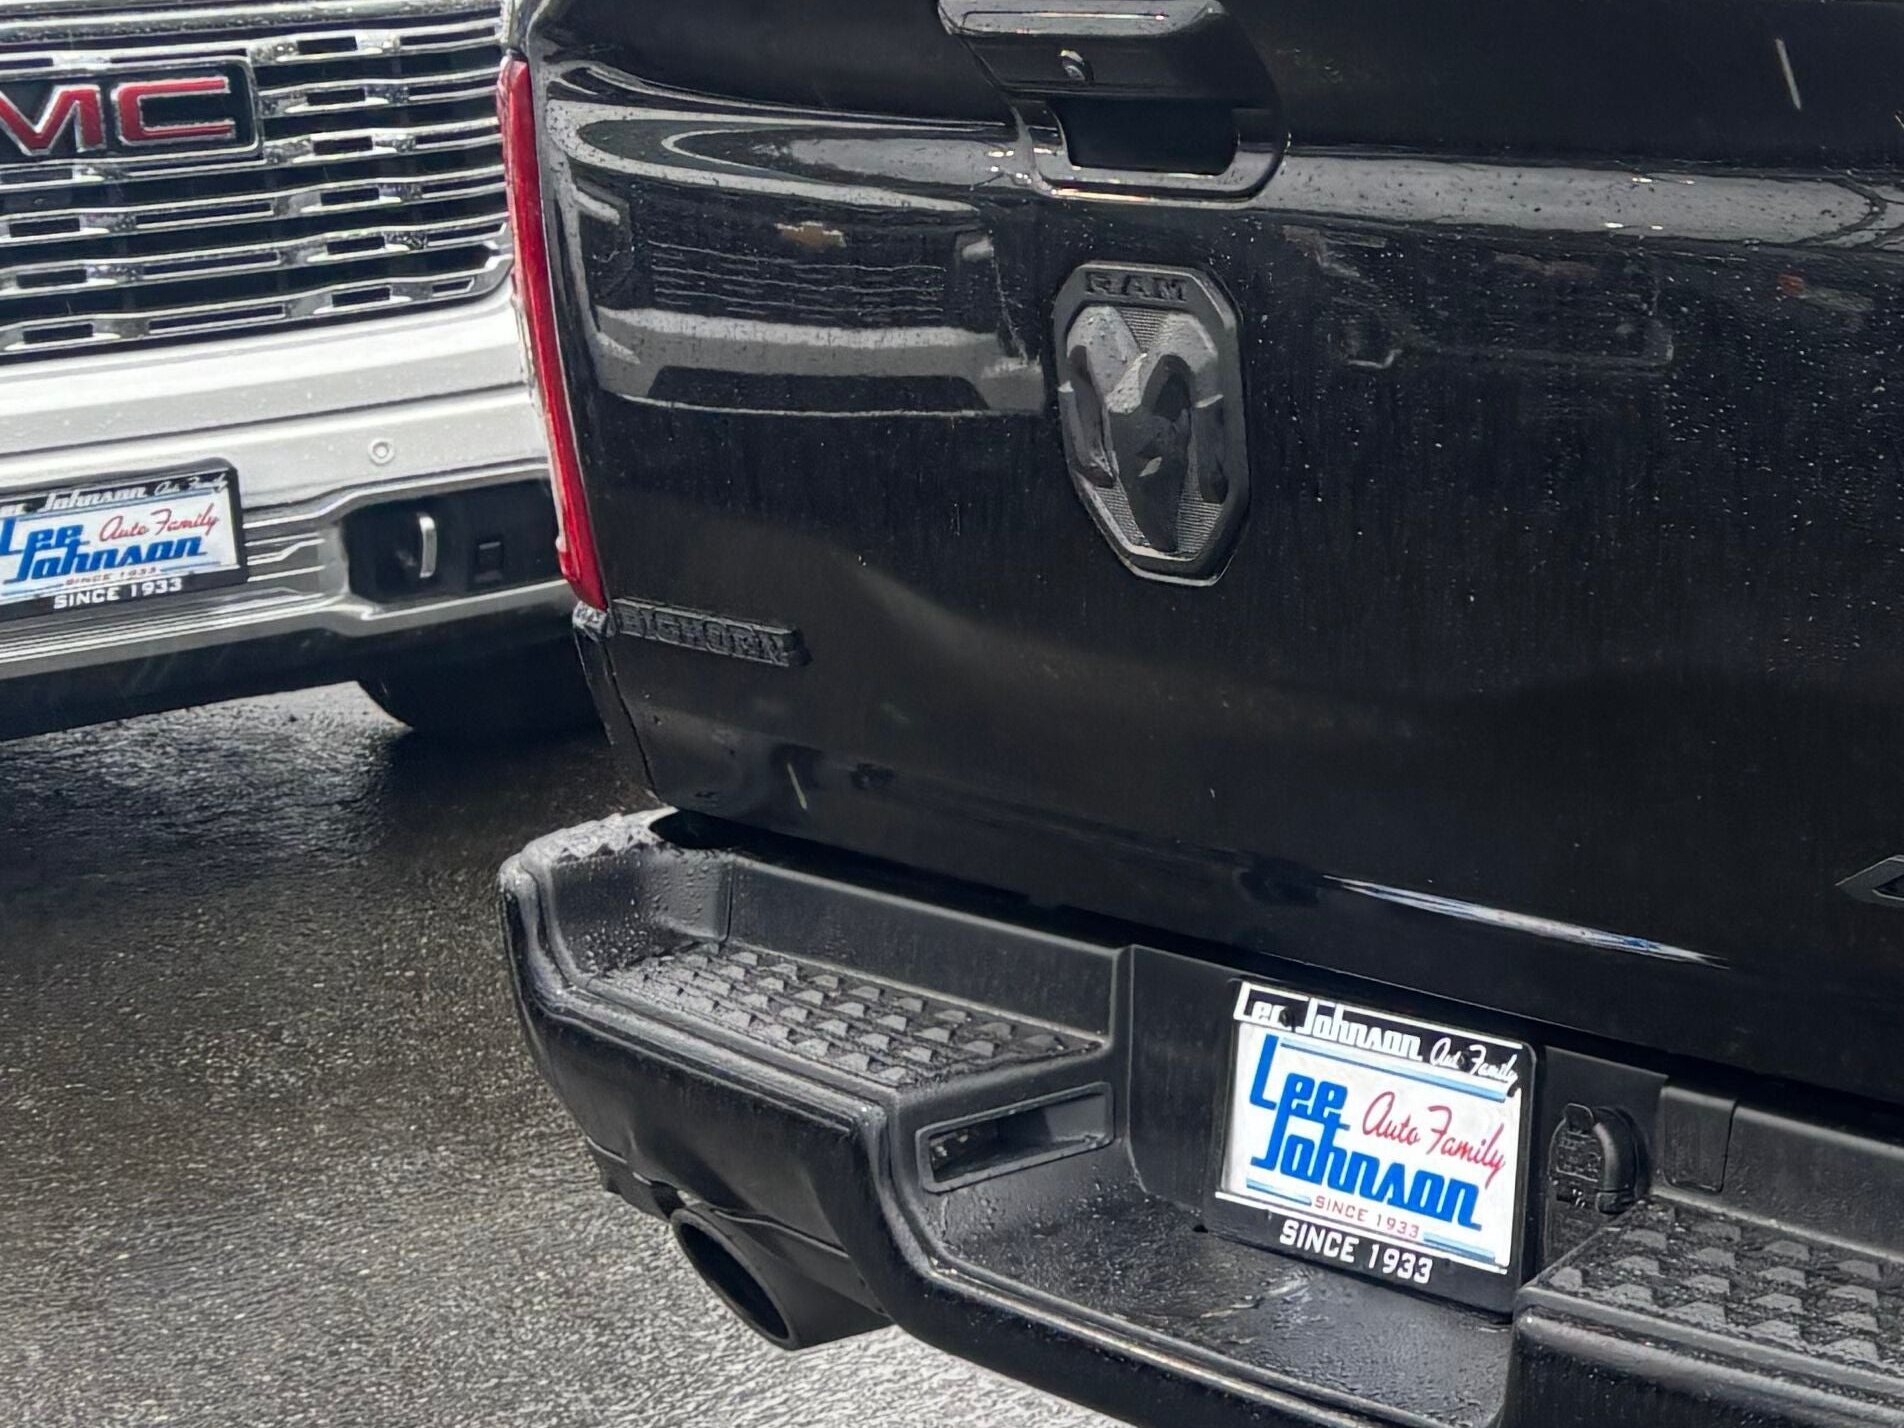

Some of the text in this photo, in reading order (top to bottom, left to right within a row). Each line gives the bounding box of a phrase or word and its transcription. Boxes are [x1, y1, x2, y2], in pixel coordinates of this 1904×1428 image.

[1085, 271, 1188, 302] RAM
[0, 516, 90, 557] Lee
[99, 503, 220, 542] Auto Family
[3, 534, 208, 584] Johnson
[53, 577, 183, 610] SINCE 1933
[1295, 997, 1423, 1062] Johnson
[1249, 1034, 1350, 1131] Lee
[1361, 1090, 1506, 1190] Auto Family
[1249, 1106, 1483, 1232] Johnson
[1315, 1194, 1421, 1240] SINCE 1933
[1279, 1218, 1434, 1285] SINCE 1933
